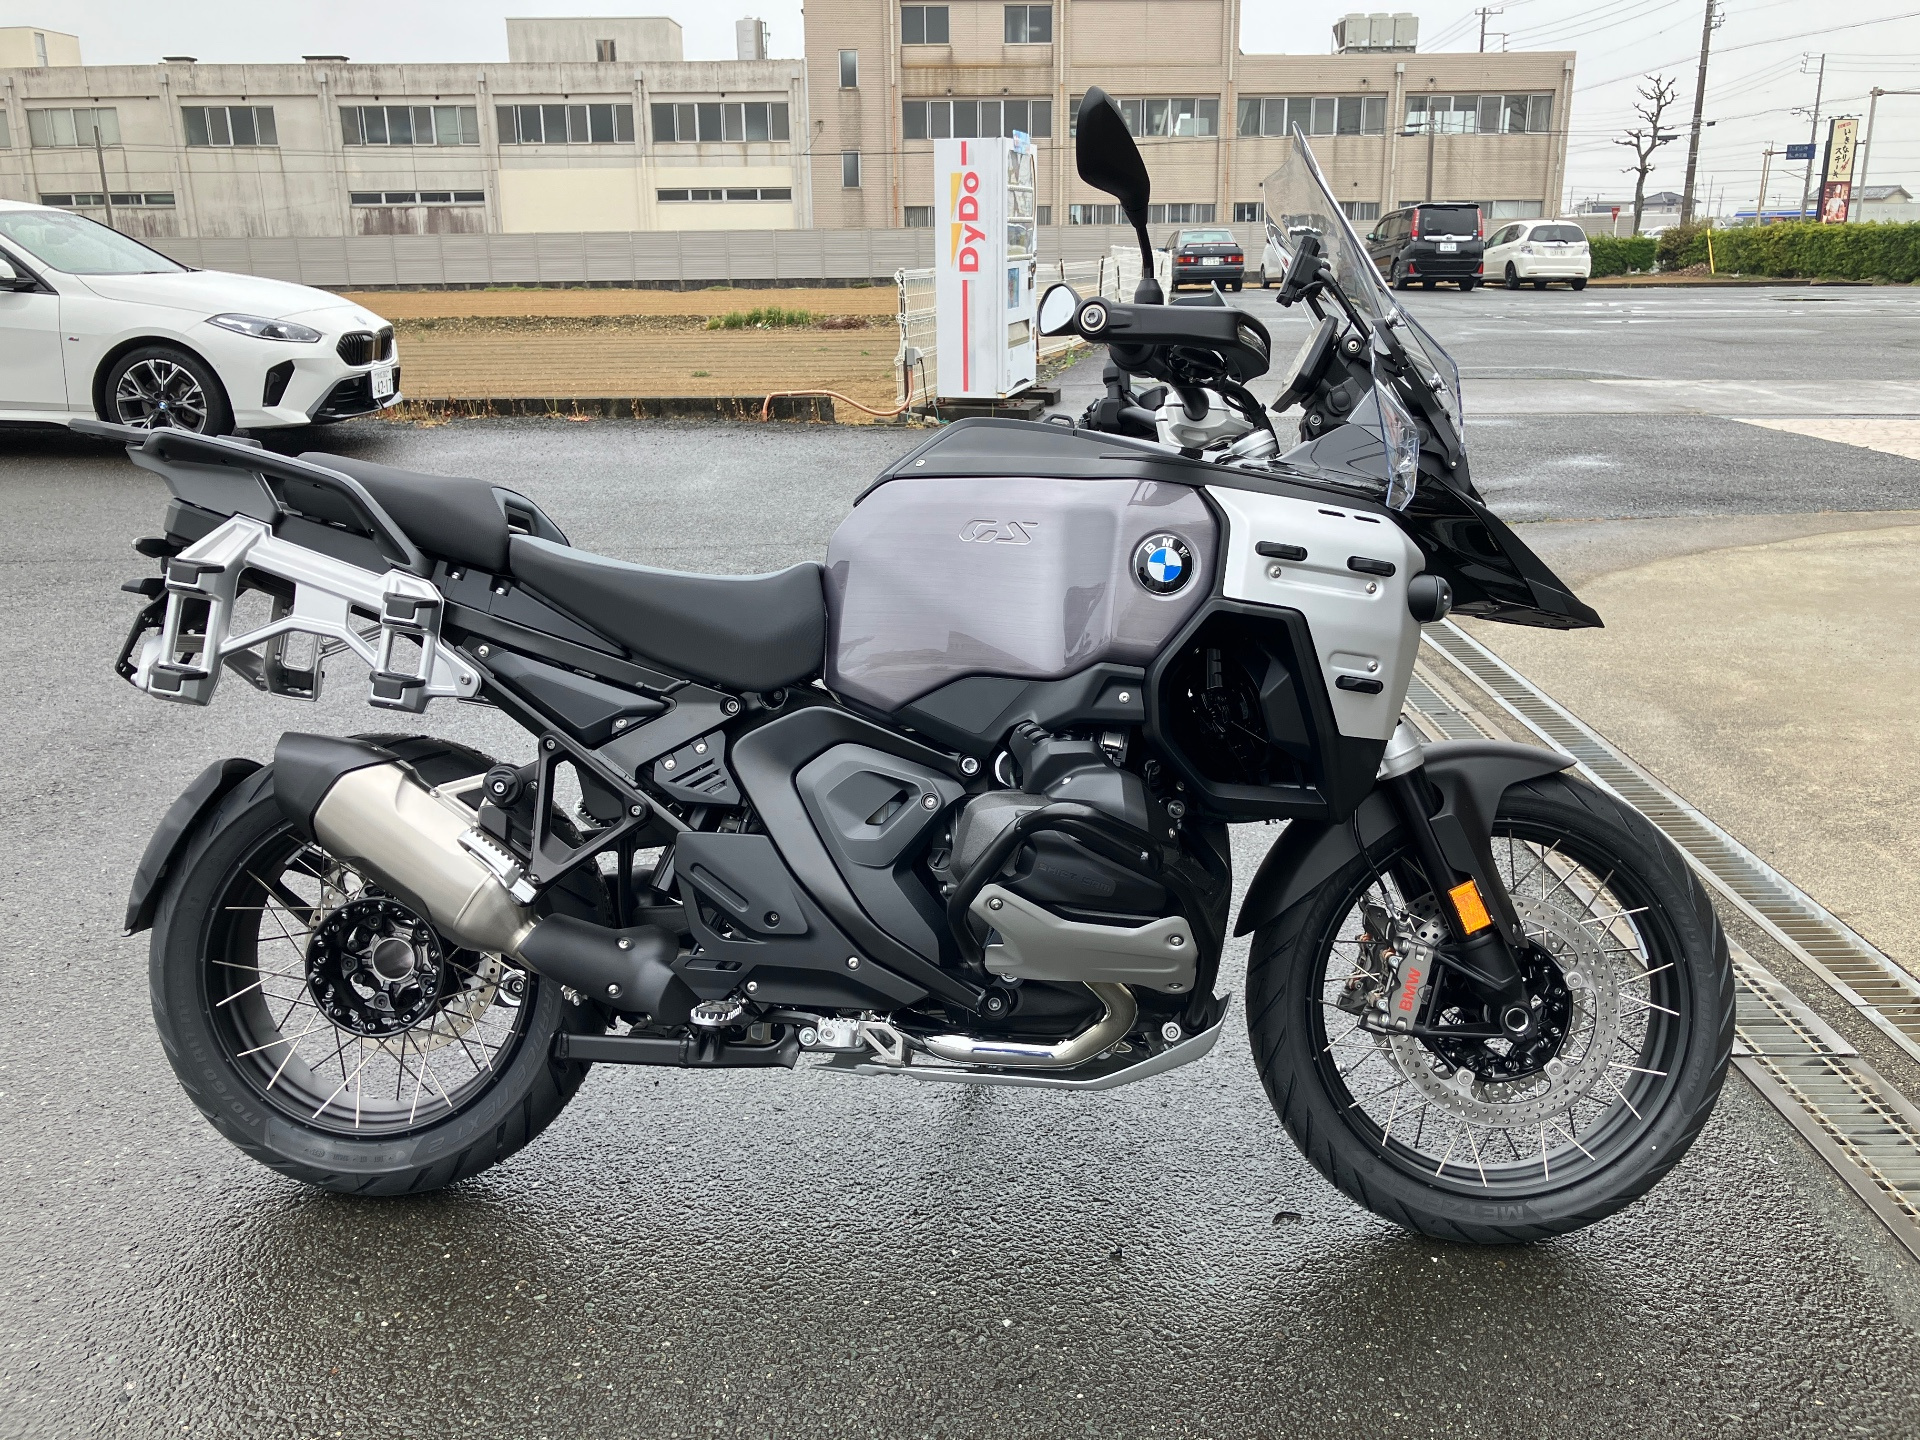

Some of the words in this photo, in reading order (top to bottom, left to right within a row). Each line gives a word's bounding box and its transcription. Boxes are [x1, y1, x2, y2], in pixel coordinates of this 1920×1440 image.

[1842, 128, 1851, 162] いきなり
[1833, 147, 1842, 178] ステーキ
[958, 171, 986, 272] DyDo
[958, 517, 1040, 546] GS
[1143, 535, 1192, 561] BMW
[1398, 967, 1422, 1012] BMW
